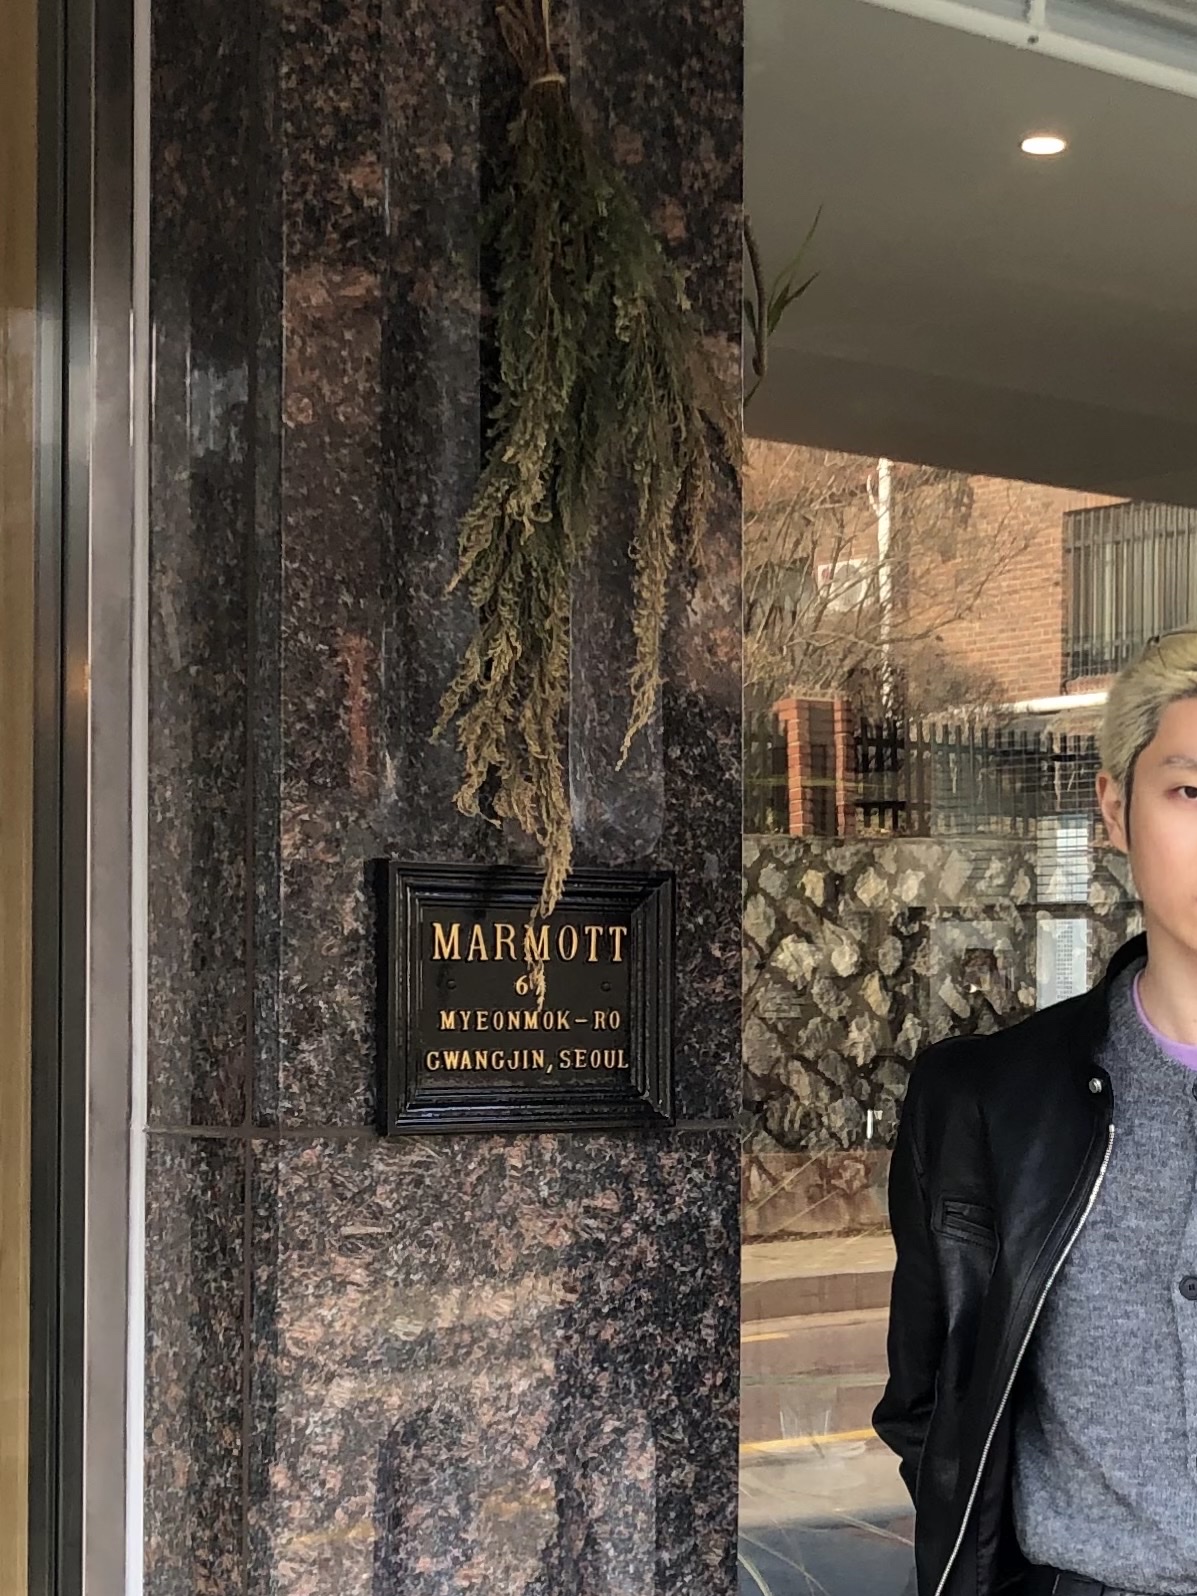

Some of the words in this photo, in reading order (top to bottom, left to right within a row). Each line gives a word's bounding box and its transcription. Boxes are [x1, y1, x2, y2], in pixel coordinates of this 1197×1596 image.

[432, 922, 627, 962] MARMOTT
[515, 974, 546, 997] 6
[560, 1049, 629, 1070] SEOUL
